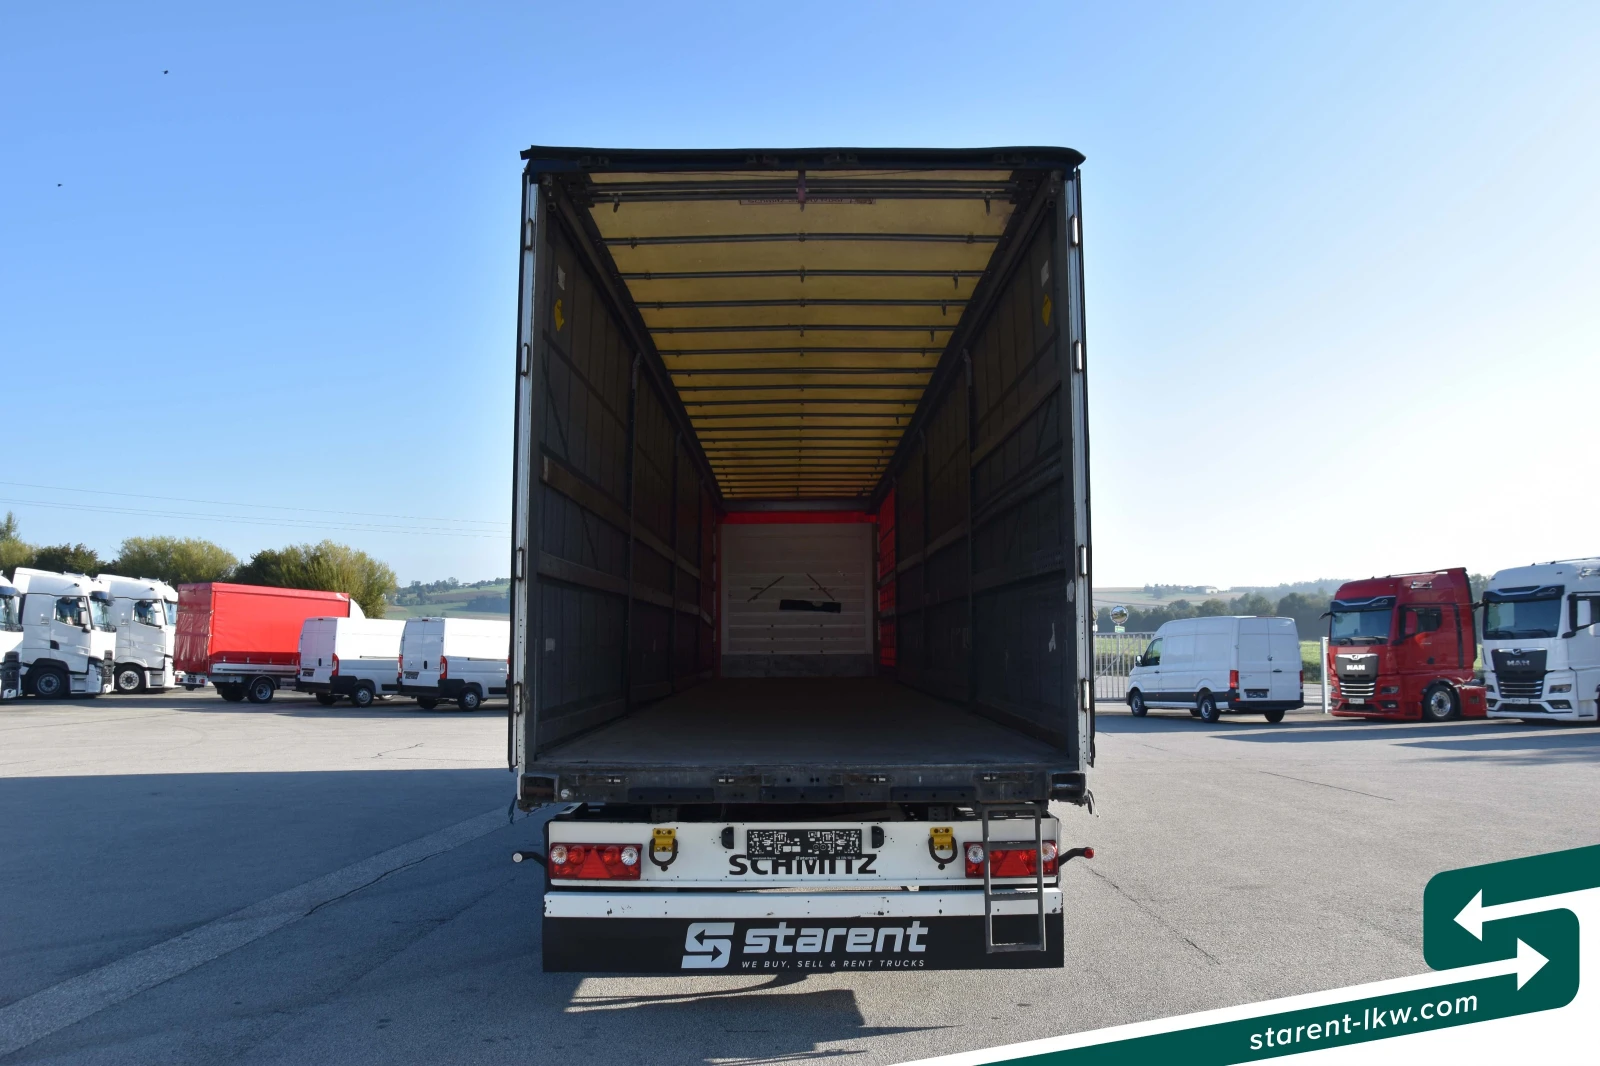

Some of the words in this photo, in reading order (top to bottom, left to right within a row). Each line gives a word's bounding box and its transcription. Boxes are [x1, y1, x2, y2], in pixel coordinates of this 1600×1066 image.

[743, 920, 929, 954] starent
[741, 960, 758, 968] WE
[763, 960, 791, 968] BUY,
[797, 960, 824, 968] SELL
[843, 959, 873, 967] RENT
[879, 959, 925, 967] TRUCKS
